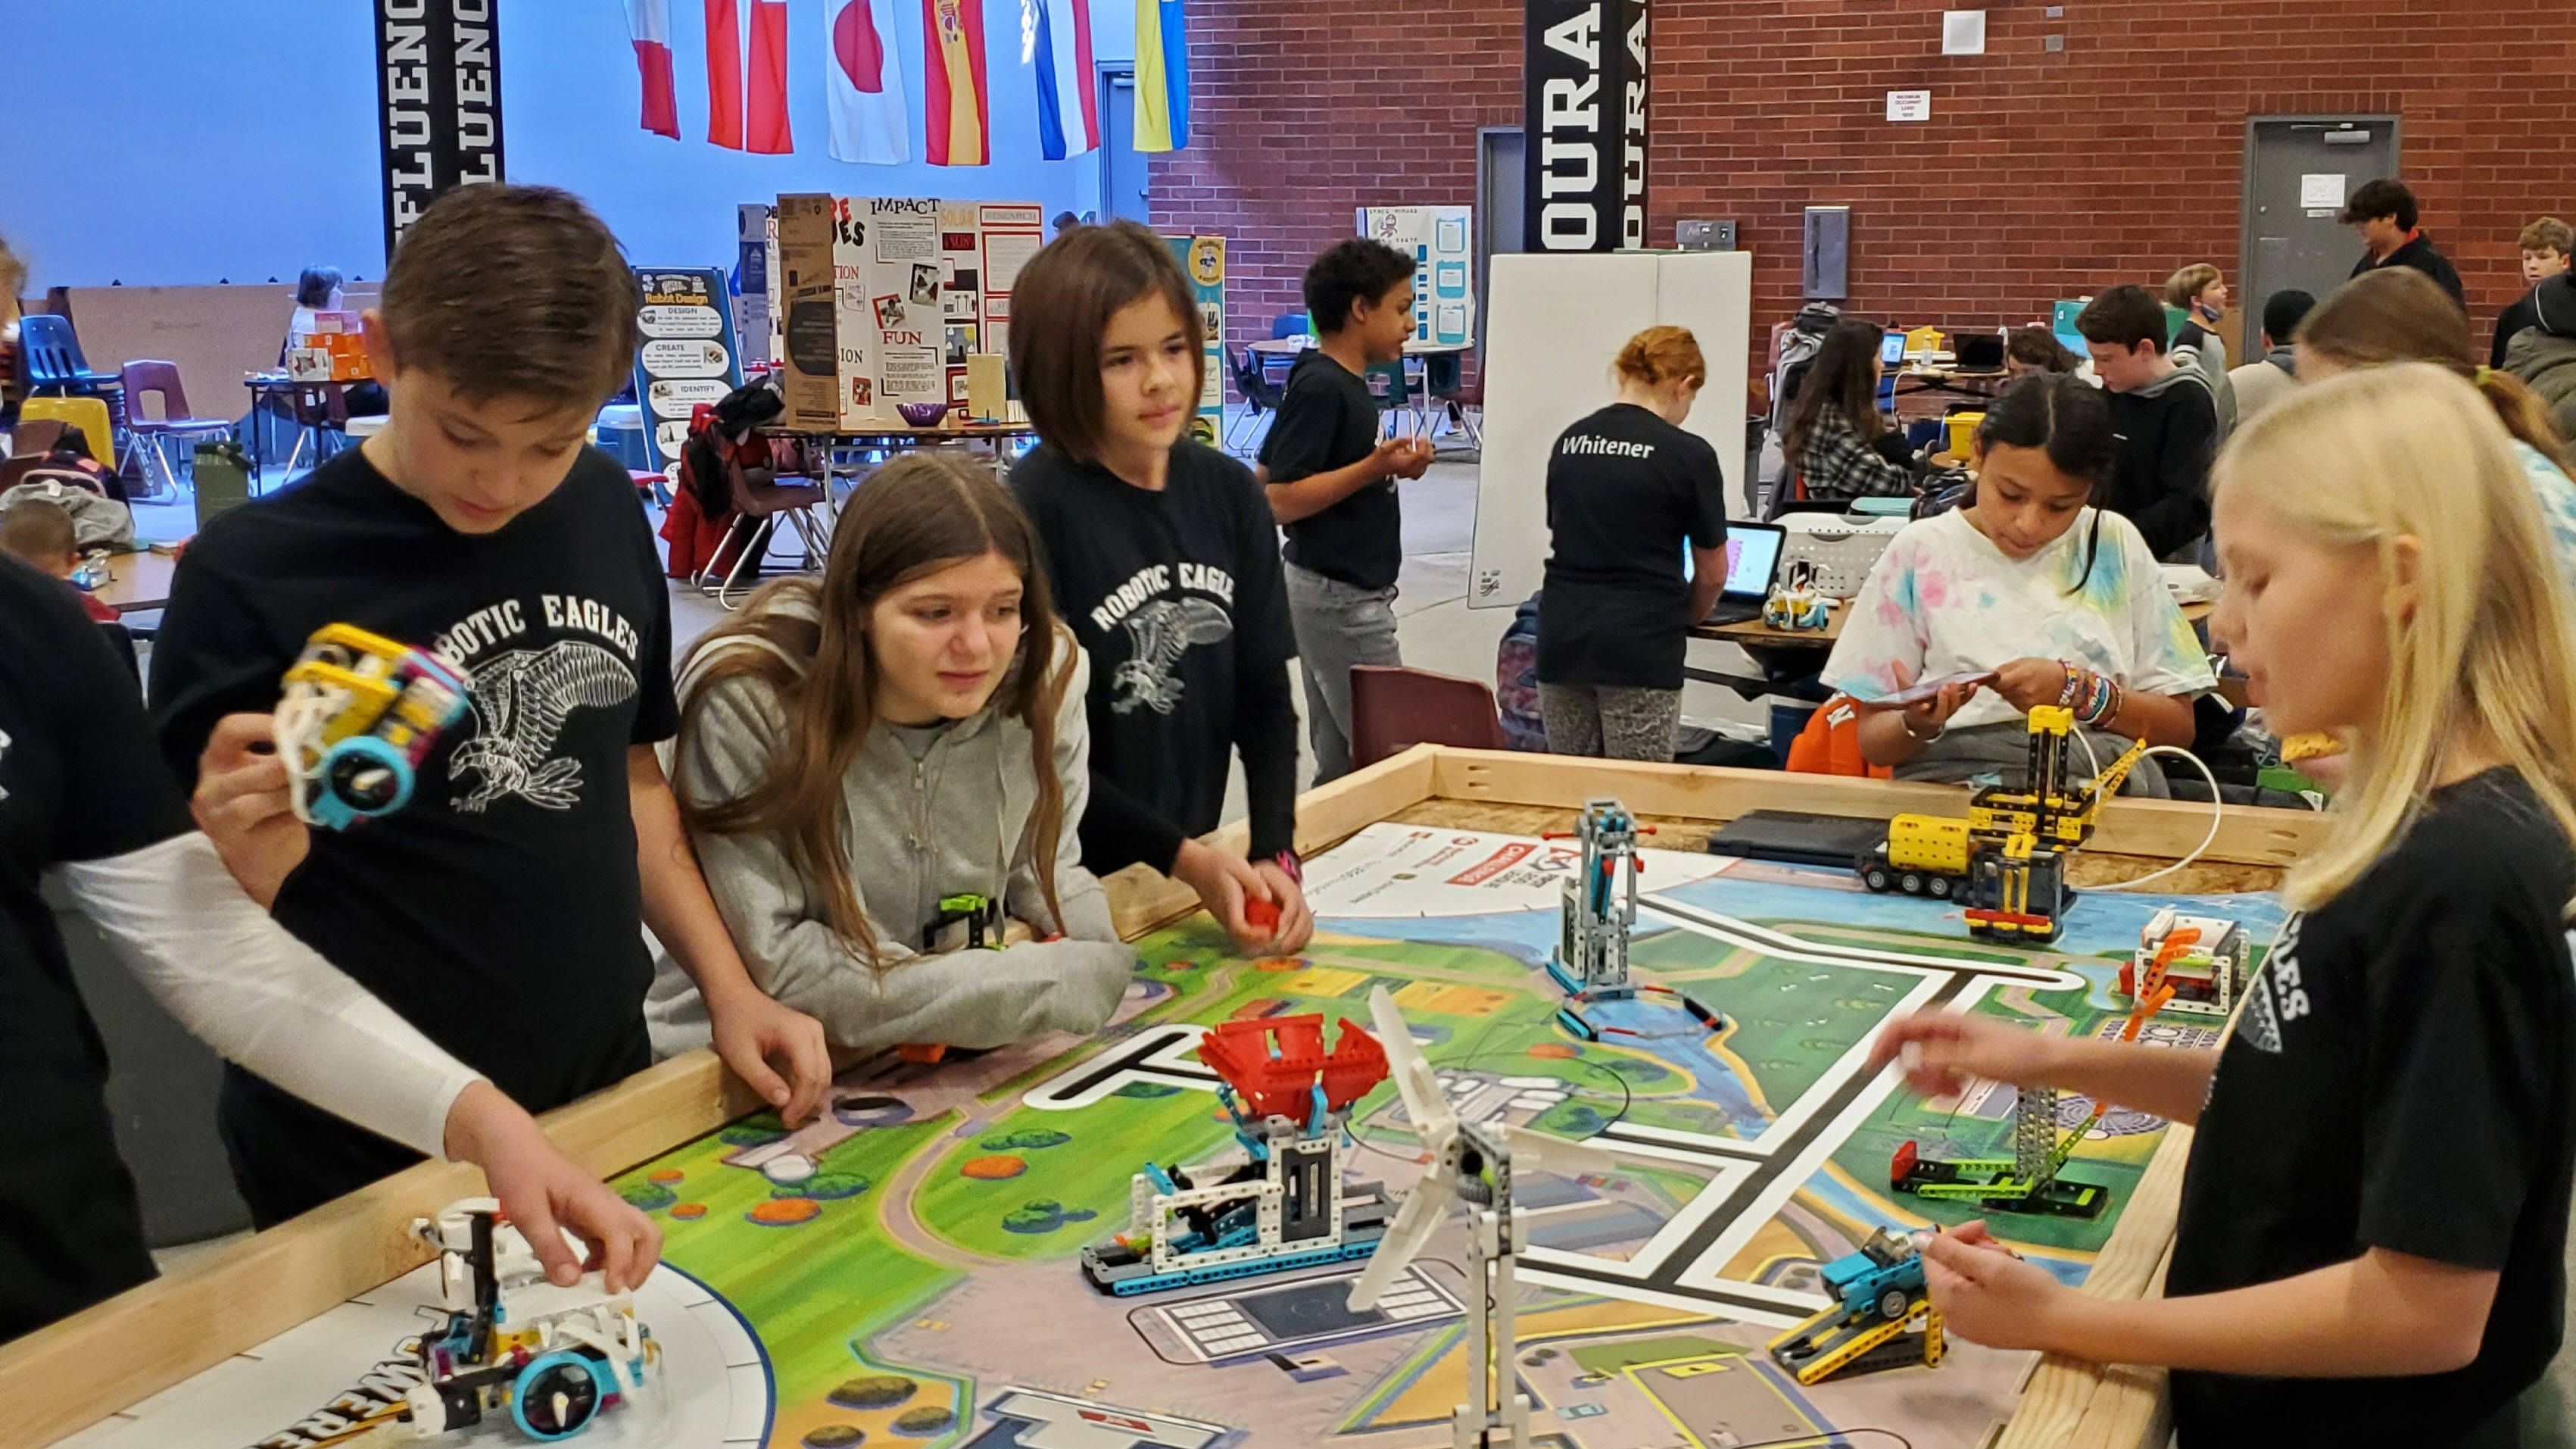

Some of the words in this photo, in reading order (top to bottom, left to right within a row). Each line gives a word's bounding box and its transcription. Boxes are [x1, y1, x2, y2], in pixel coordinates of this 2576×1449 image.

[1541, 2, 1601, 250] OURA
[1623, 0, 1646, 249] OURA
[871, 198, 941, 215] IMPACT
[985, 212, 1037, 221] RESEARCH
[882, 331, 922, 345] FUN
[1562, 435, 1654, 459] Whitener
[1090, 564, 1171, 632] ROBOTIC
[541, 594, 638, 660] EAGLES
